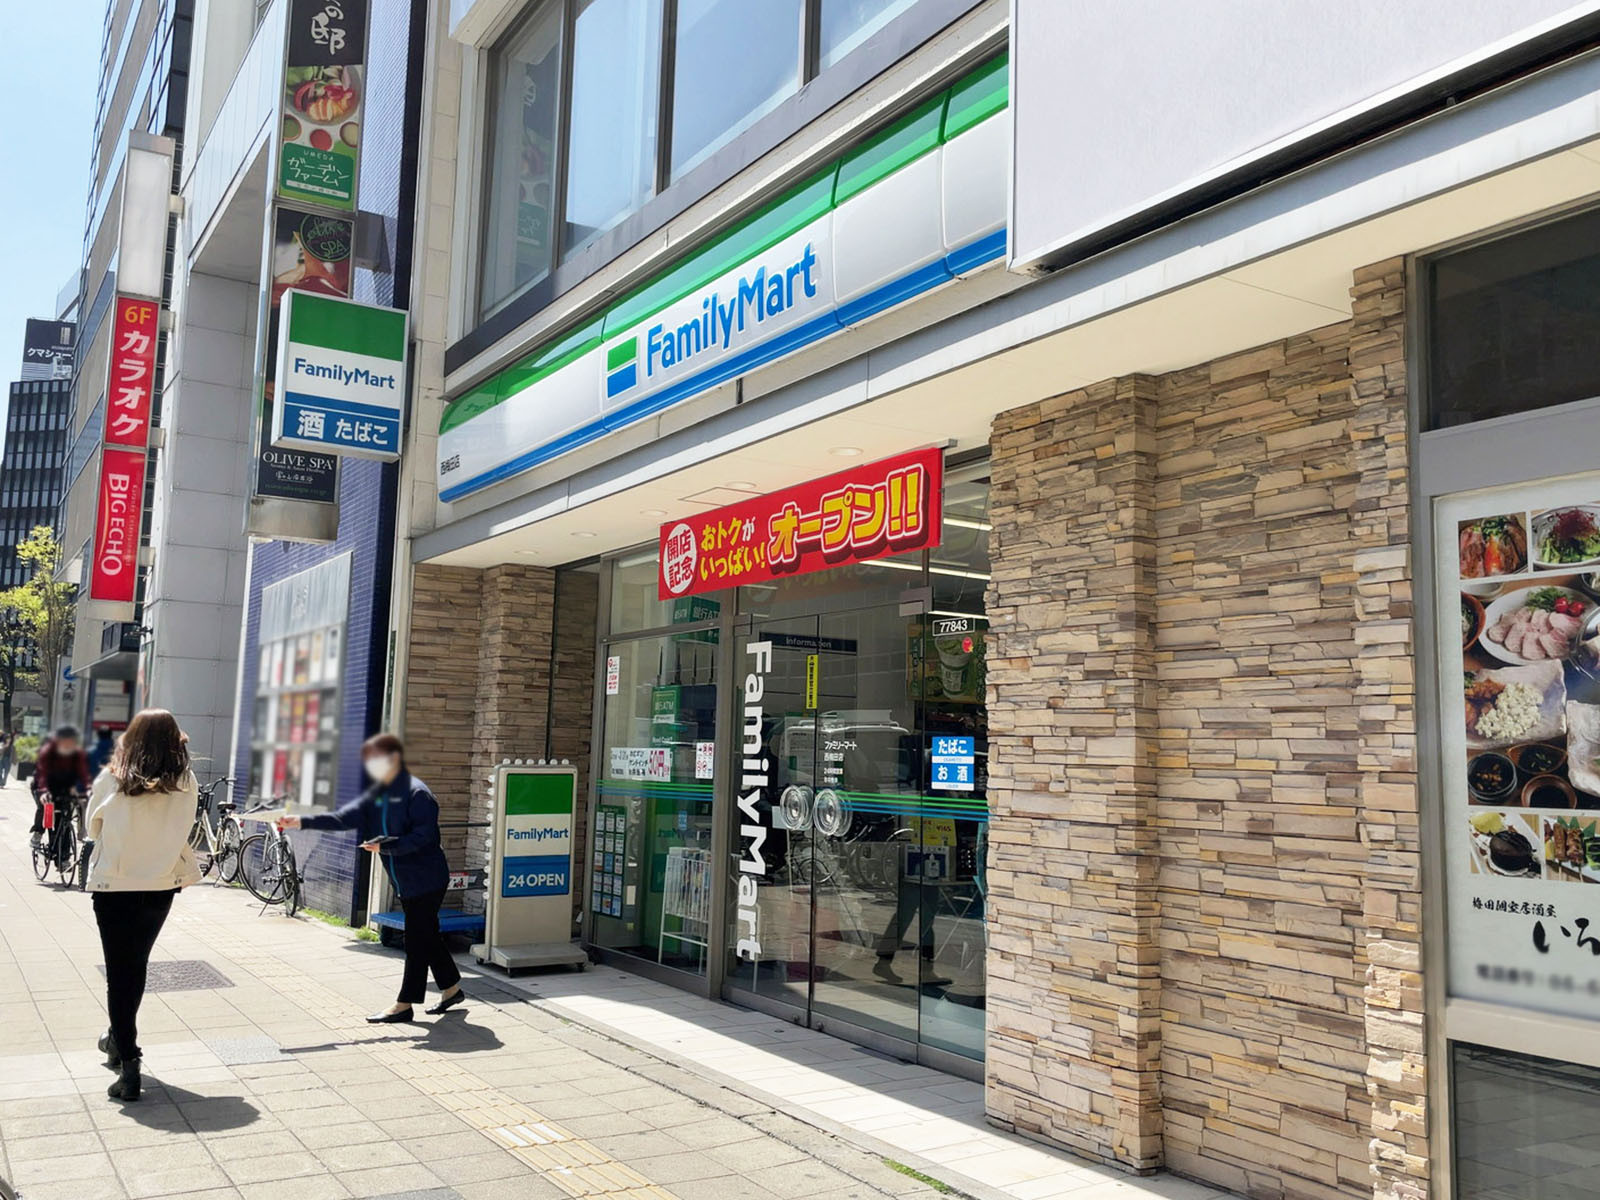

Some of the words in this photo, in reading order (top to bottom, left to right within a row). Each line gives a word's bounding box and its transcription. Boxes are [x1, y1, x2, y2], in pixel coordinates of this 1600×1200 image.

[311, 0, 346, 55] の邸
[303, 150, 334, 161] UMEDA
[288, 157, 350, 179] ガーデン
[290, 167, 339, 186] ファーム
[125, 306, 152, 325] 6F
[648, 242, 816, 377] FamilyMart
[27, 347, 74, 360] クマシュー
[112, 330, 150, 437] カラオケ
[294, 358, 395, 389] FamilyMart
[297, 410, 326, 439] 酒
[335, 419, 388, 445] たばこ
[263, 451, 306, 467] OLIVE
[309, 457, 333, 471] SPA
[108, 472, 130, 513] BIG
[701, 516, 756, 551] おトクが
[101, 517, 125, 576] ECHO
[668, 528, 691, 562] 開店
[669, 555, 693, 589] 記念
[940, 620, 968, 633] 77843
[785, 636, 832, 648] Informaion
[824, 741, 857, 750] ファミリーマート
[938, 739, 968, 754] たばこ
[938, 765, 969, 781] お酒
[737, 641, 772, 961] FamilyMart
[507, 828, 569, 842] FamilyMart
